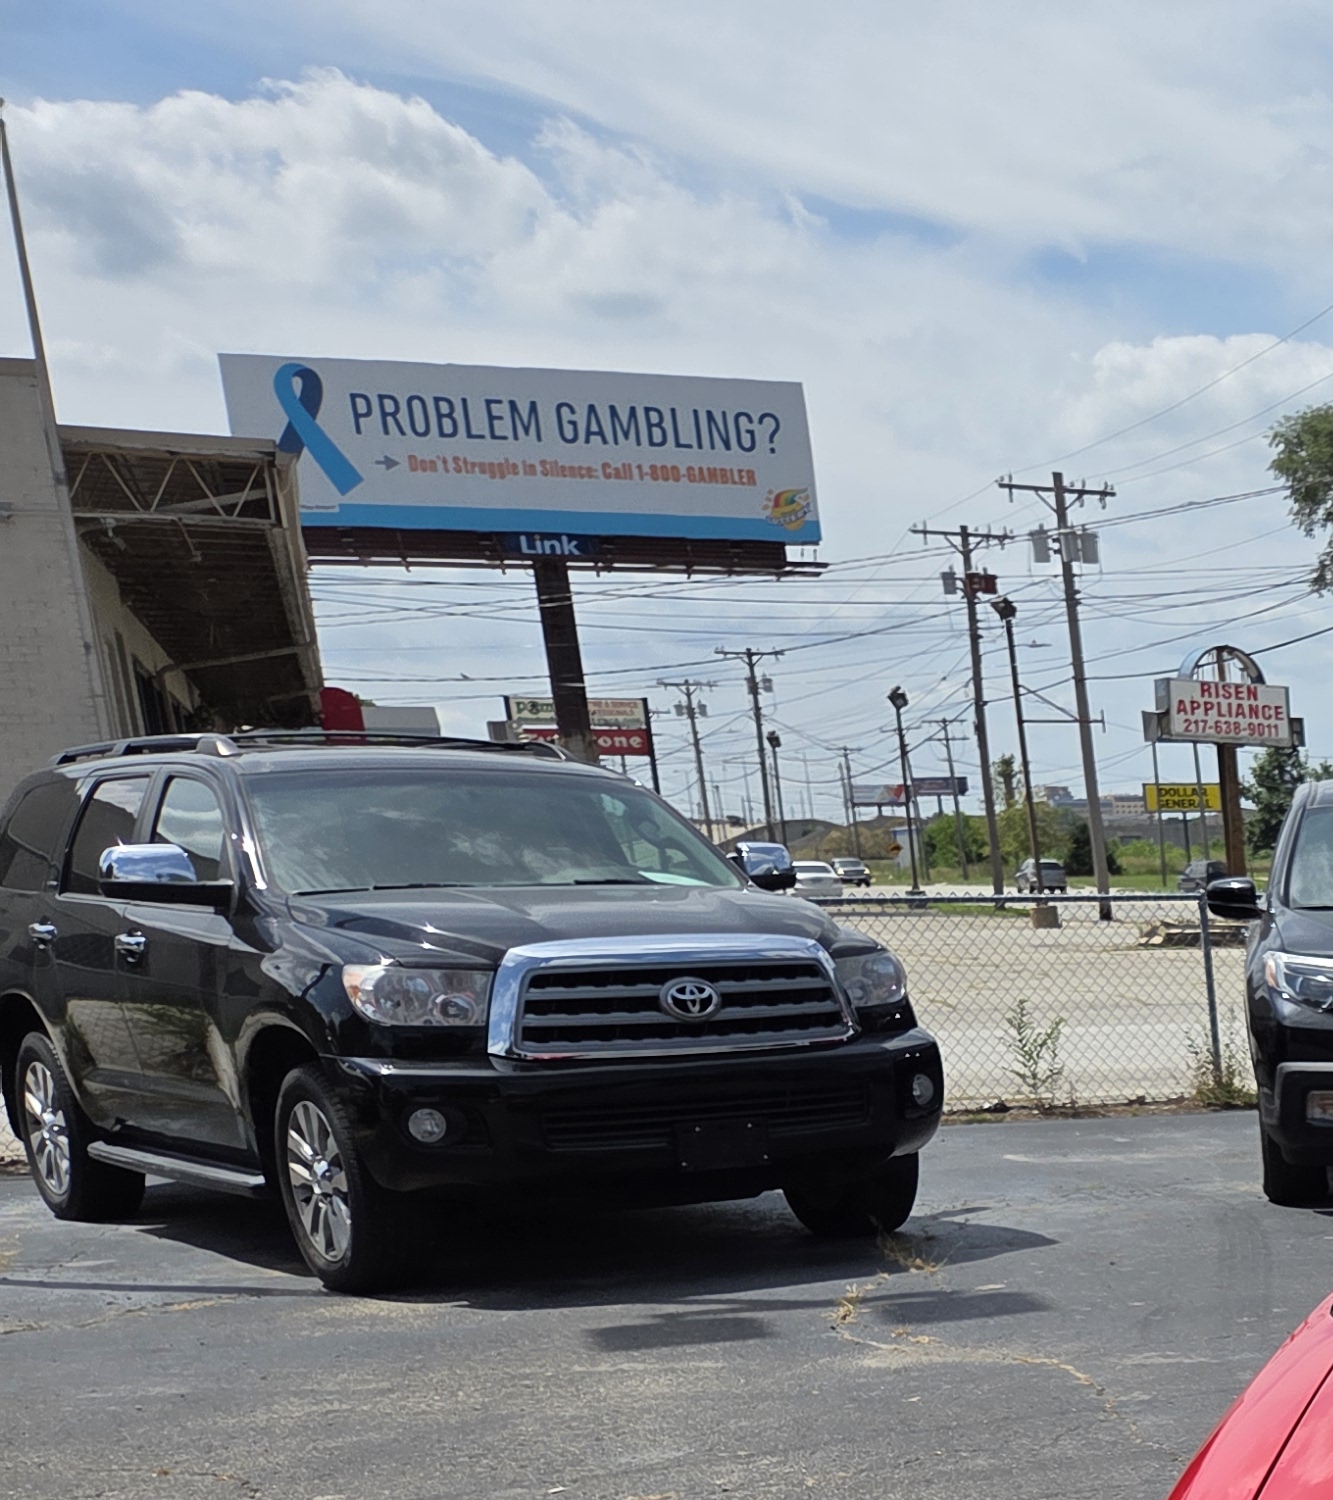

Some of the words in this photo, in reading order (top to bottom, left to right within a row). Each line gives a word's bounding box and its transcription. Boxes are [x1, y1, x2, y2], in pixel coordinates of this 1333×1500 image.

[349, 392, 542, 443] PROBLEM
[555, 402, 781, 454] GAMBLING?
[407, 454, 450, 474] Don't
[452, 456, 520, 480] Struggle
[521, 459, 537, 476] in
[601, 462, 634, 481] Call
[636, 464, 757, 487] 1-800-GAMBLER
[520, 534, 582, 555] Link
[1200, 682, 1259, 701] RISEN
[1176, 699, 1285, 721] APPLIANCE
[1183, 719, 1279, 738] 217-638-9011
[1159, 787, 1208, 798] DOLLAR
